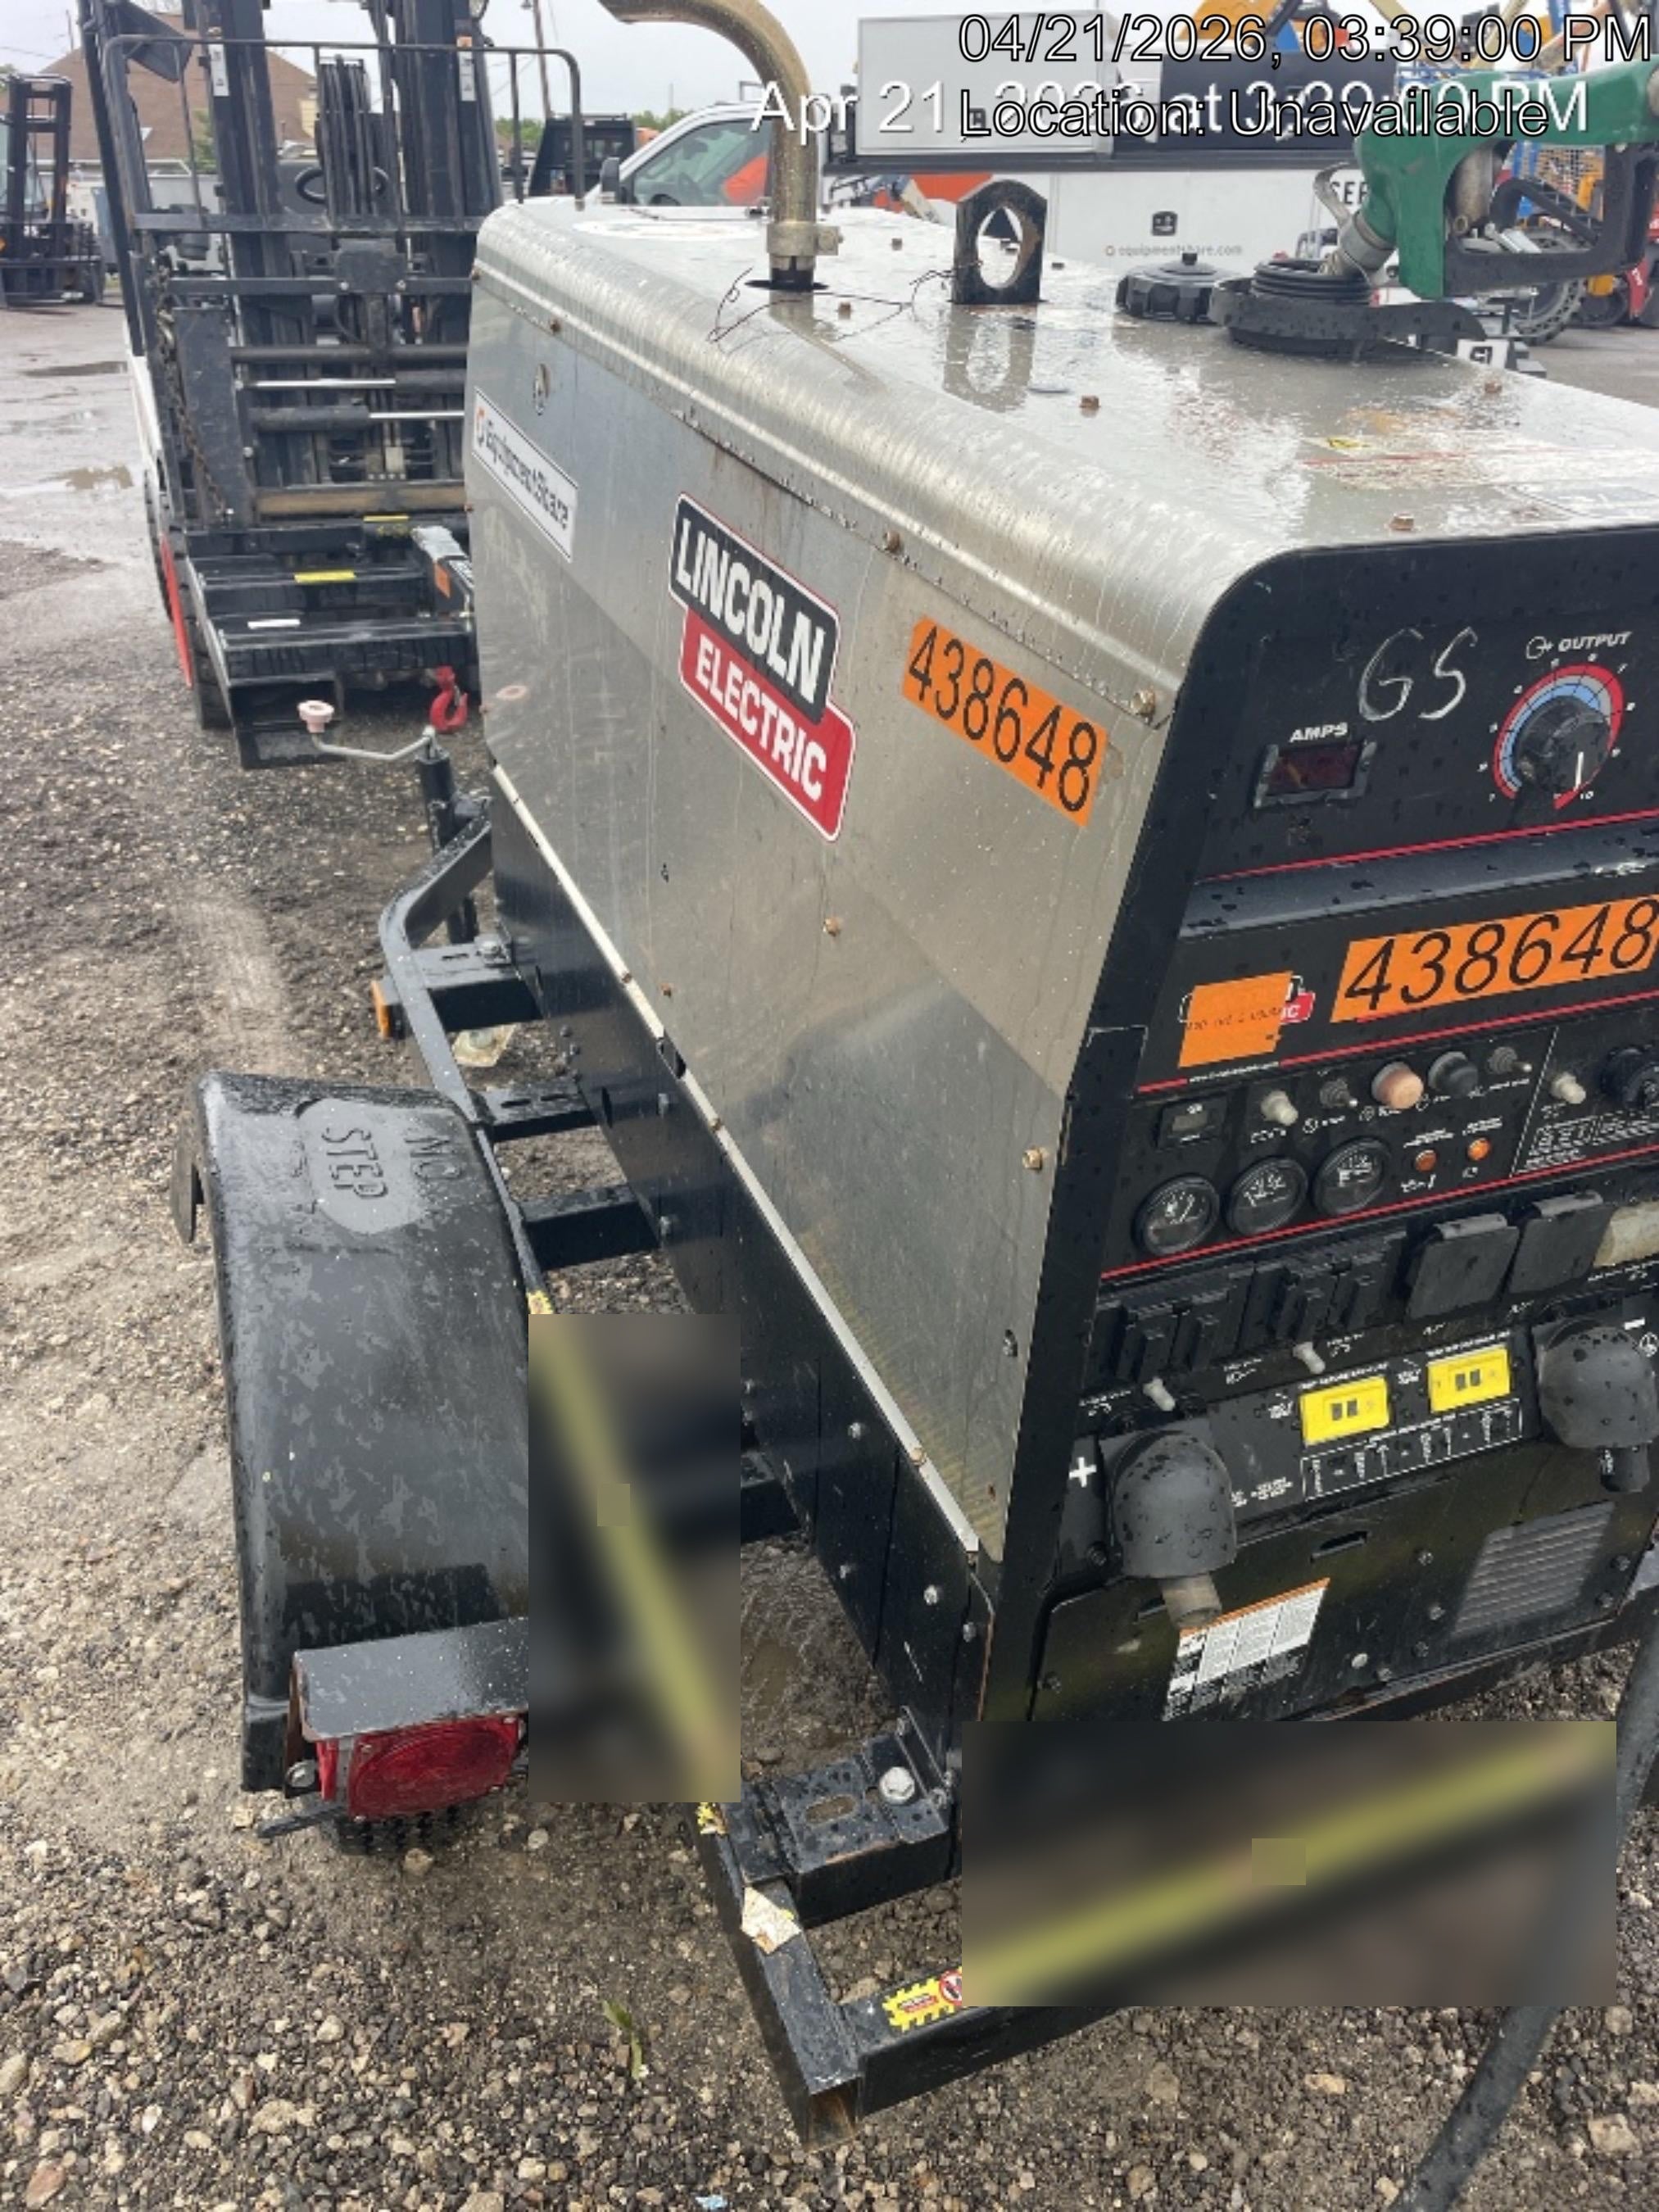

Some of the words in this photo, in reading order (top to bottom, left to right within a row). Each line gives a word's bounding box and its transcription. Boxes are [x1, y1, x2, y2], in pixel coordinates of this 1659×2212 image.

[675, 519, 827, 705] LINCOLN
[1557, 632, 1633, 653] OUTPUT
[696, 638, 828, 803] ELECTRIC
[907, 623, 1099, 814] 438648
[1289, 722, 1349, 744] AMPS
[1344, 899, 1659, 1010] 438648
[320, 1123, 389, 1199] STEP
